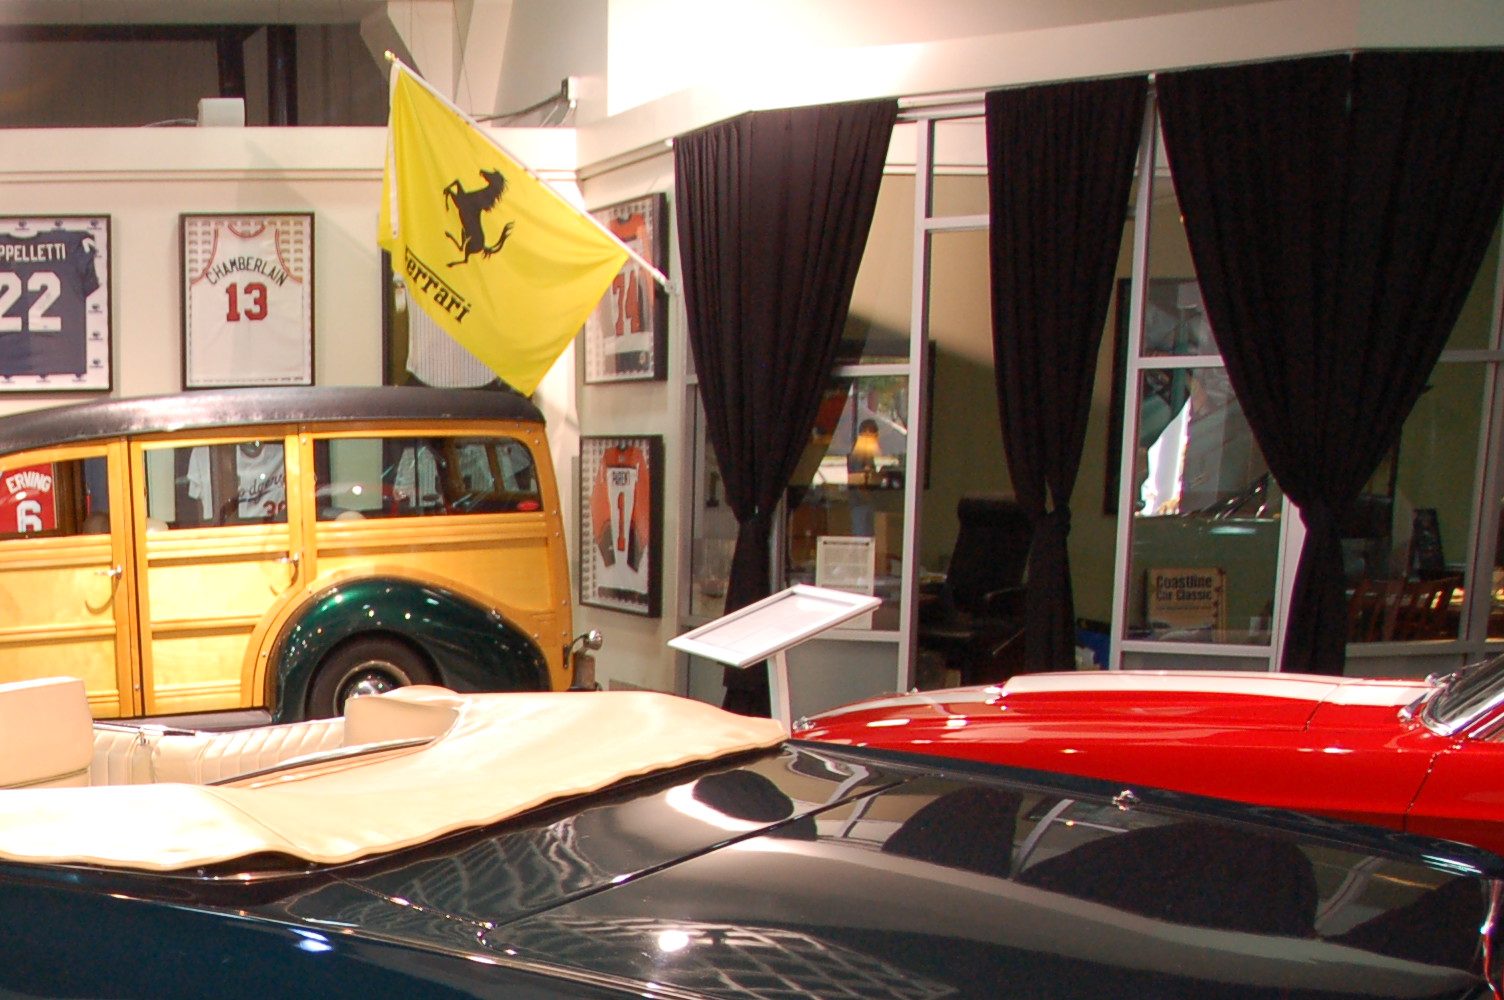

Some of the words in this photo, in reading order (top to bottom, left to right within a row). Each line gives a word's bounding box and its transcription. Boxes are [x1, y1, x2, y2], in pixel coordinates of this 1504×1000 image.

[204, 255, 289, 288] CHAMBERLAIN
[405, 246, 472, 324] errari
[225, 281, 269, 322] 13
[612, 269, 643, 337] 74
[5, 470, 53, 494] ERVING
[16, 499, 43, 533] 6
[617, 491, 626, 552] 1
[1156, 574, 1213, 589] Coastline
[1156, 589, 1173, 601] Car
[1175, 588, 1213, 601] Classic
